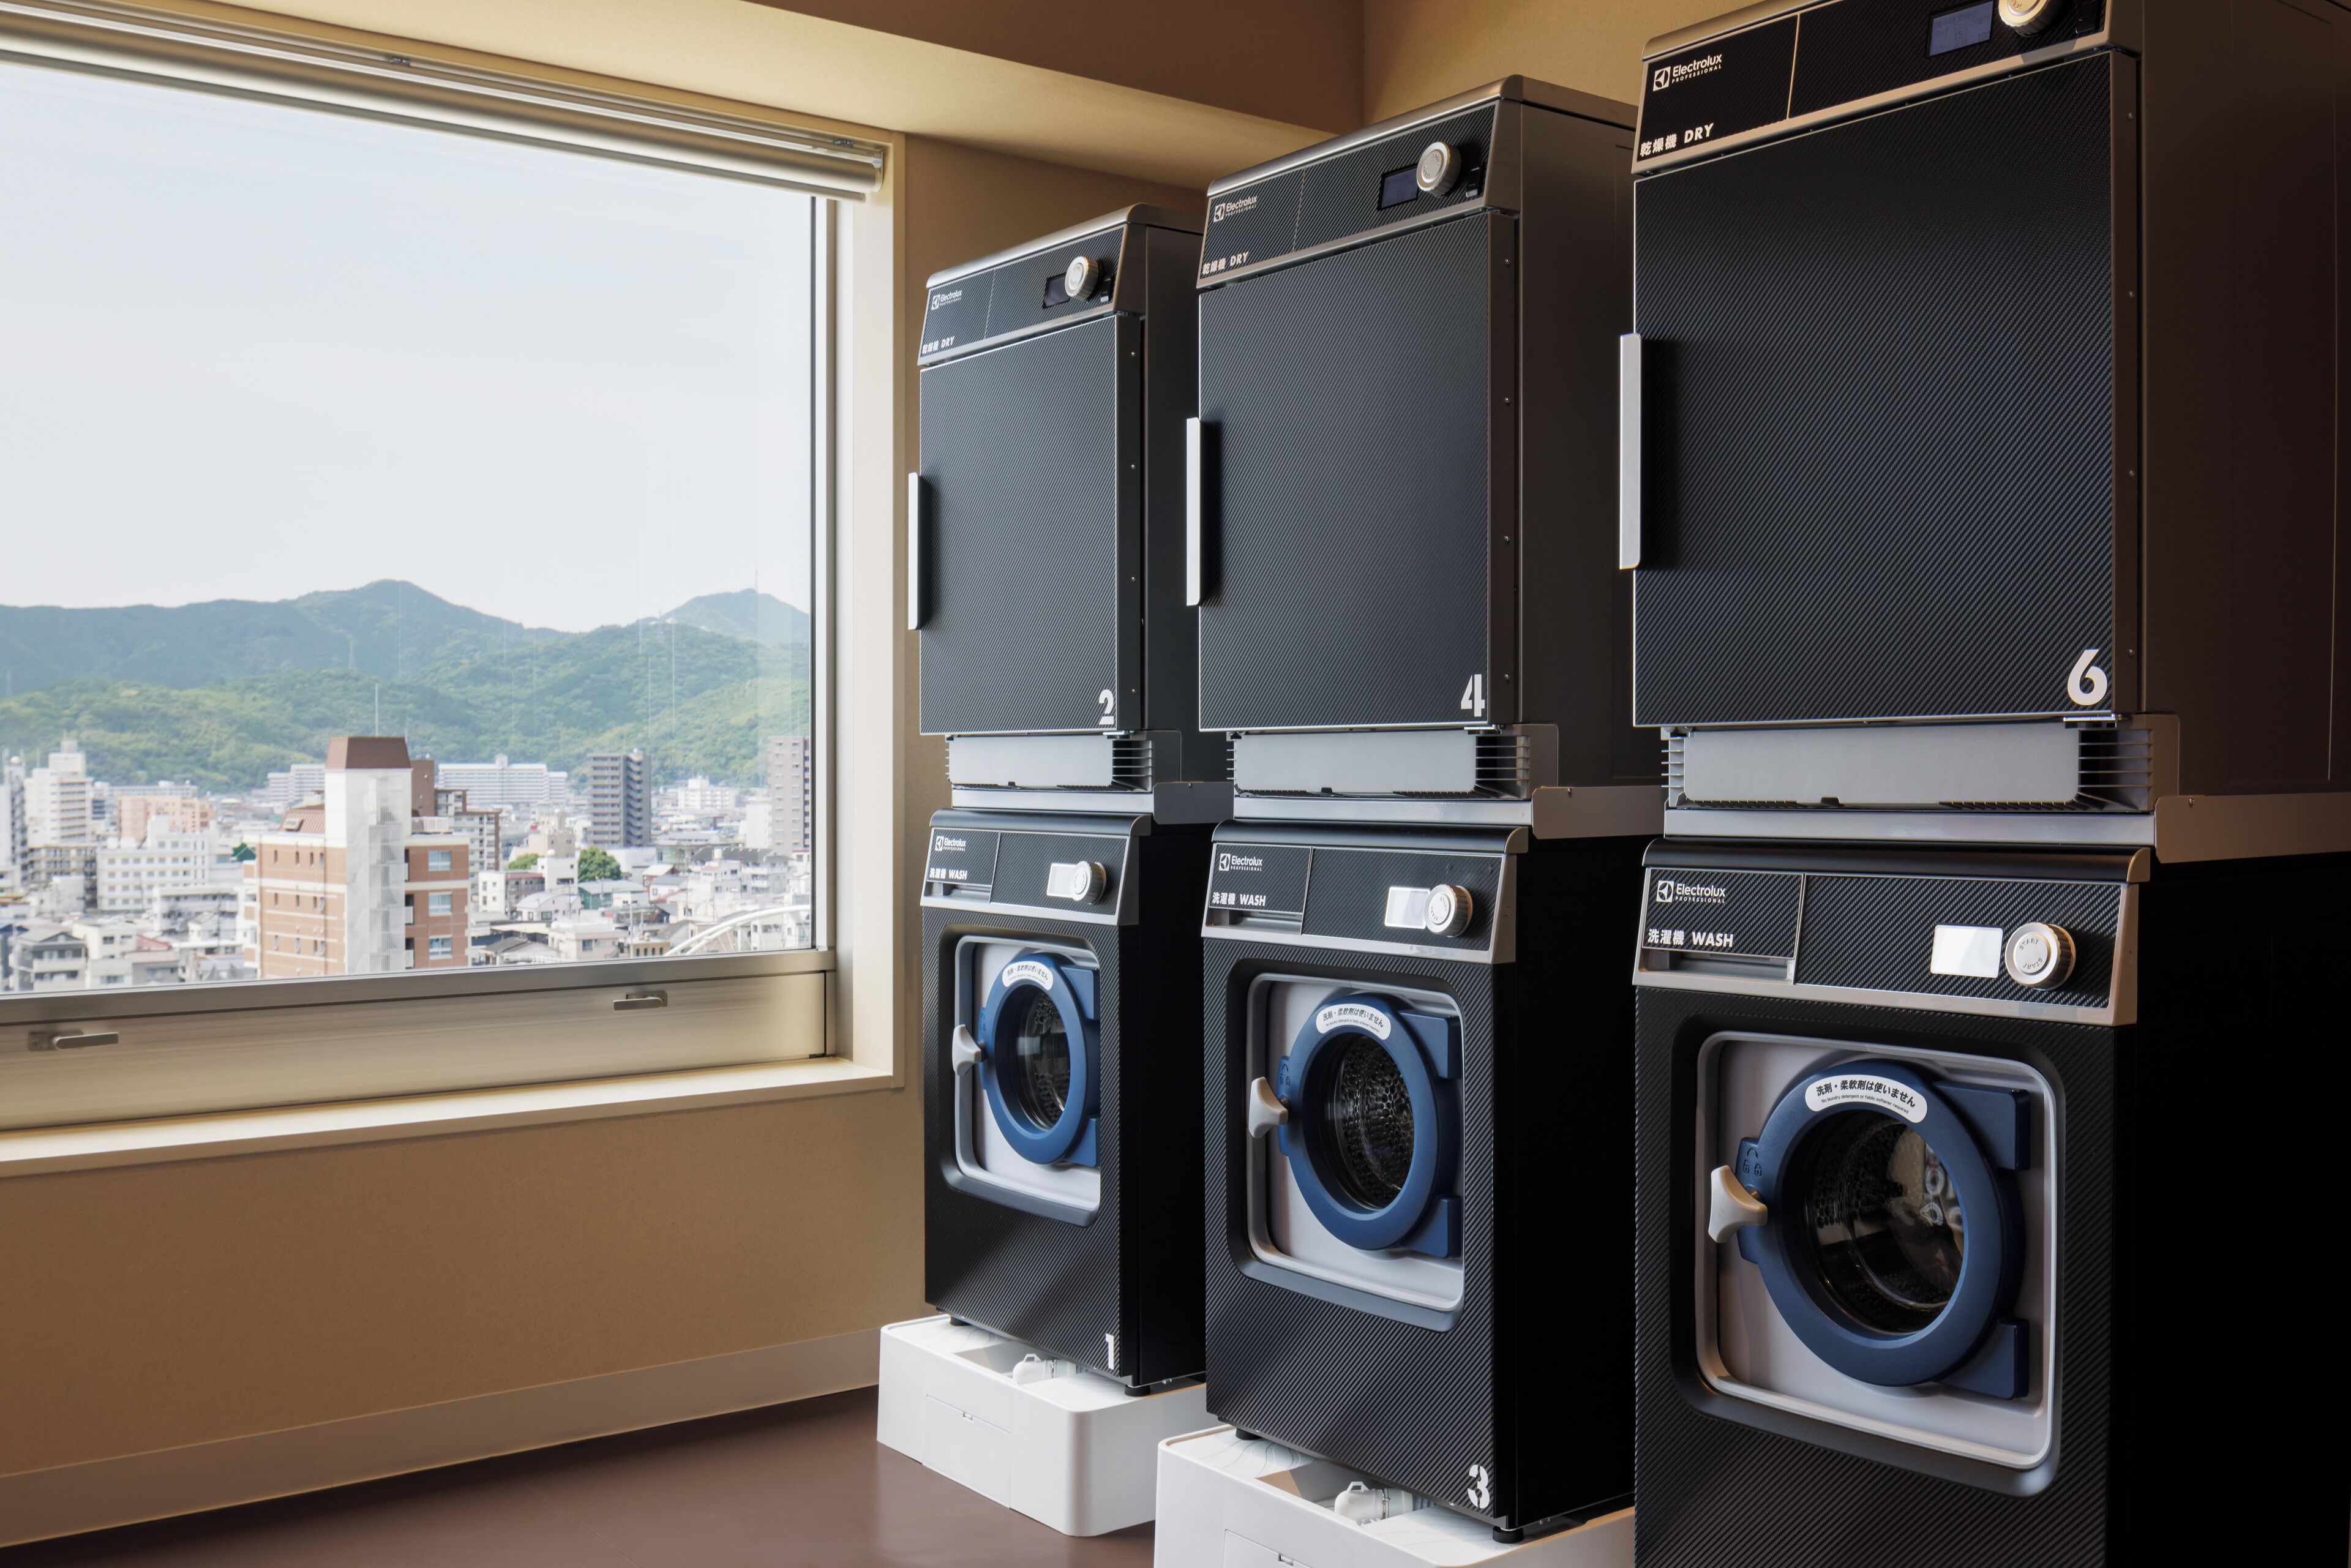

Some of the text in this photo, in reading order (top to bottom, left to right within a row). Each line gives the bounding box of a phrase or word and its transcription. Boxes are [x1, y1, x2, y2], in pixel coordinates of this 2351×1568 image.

[1672, 64, 1722, 83] PROFESSIONAL
[1673, 54, 1722, 77] Electrolux
[1640, 122, 1714, 157] 乾燥機 DRY
[1226, 195, 1258, 212] Electrolux
[1229, 251, 1249, 266] DRY
[940, 290, 962, 302] Electrolux
[941, 336, 954, 348] DRY
[2067, 648, 2107, 705] 6
[1461, 674, 1485, 717] 4
[1098, 689, 1114, 725] 2
[944, 837, 966, 847] Electrolux
[1231, 855, 1262, 866] Electrolux
[948, 869, 967, 880] WASH
[1212, 892, 1266, 906] 洗濯機 WASH
[1676, 883, 1726, 897] Electrolux
[1648, 928, 1734, 948] 洗濯機 WASH
[1816, 1079, 1915, 1108] 洗剤・柔軟剤は使いません
[1893, 1103, 1909, 1114] required
[1105, 1333, 1114, 1370] 1
[1467, 1465, 1490, 1509] 3
